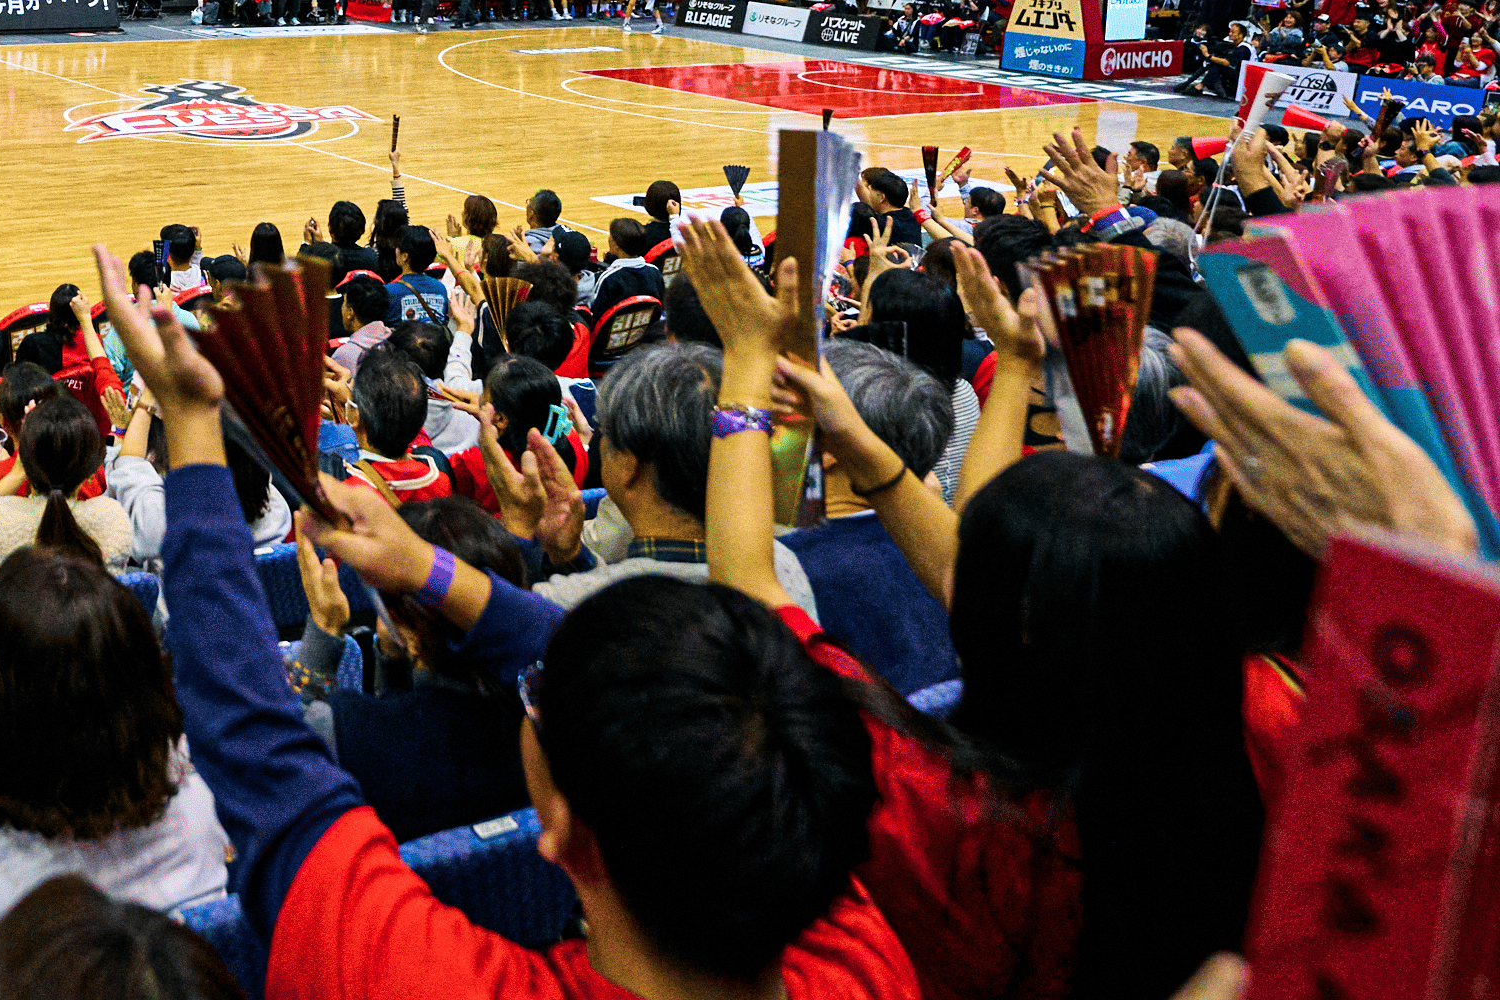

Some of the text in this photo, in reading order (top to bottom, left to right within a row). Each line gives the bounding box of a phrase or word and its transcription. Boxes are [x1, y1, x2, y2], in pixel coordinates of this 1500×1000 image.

[685, 11, 733, 29] B.LEAGUE
[821, 16, 866, 31] バスケット
[834, 30, 860, 44] LIVE
[1116, 50, 1173, 70] KINCHO
